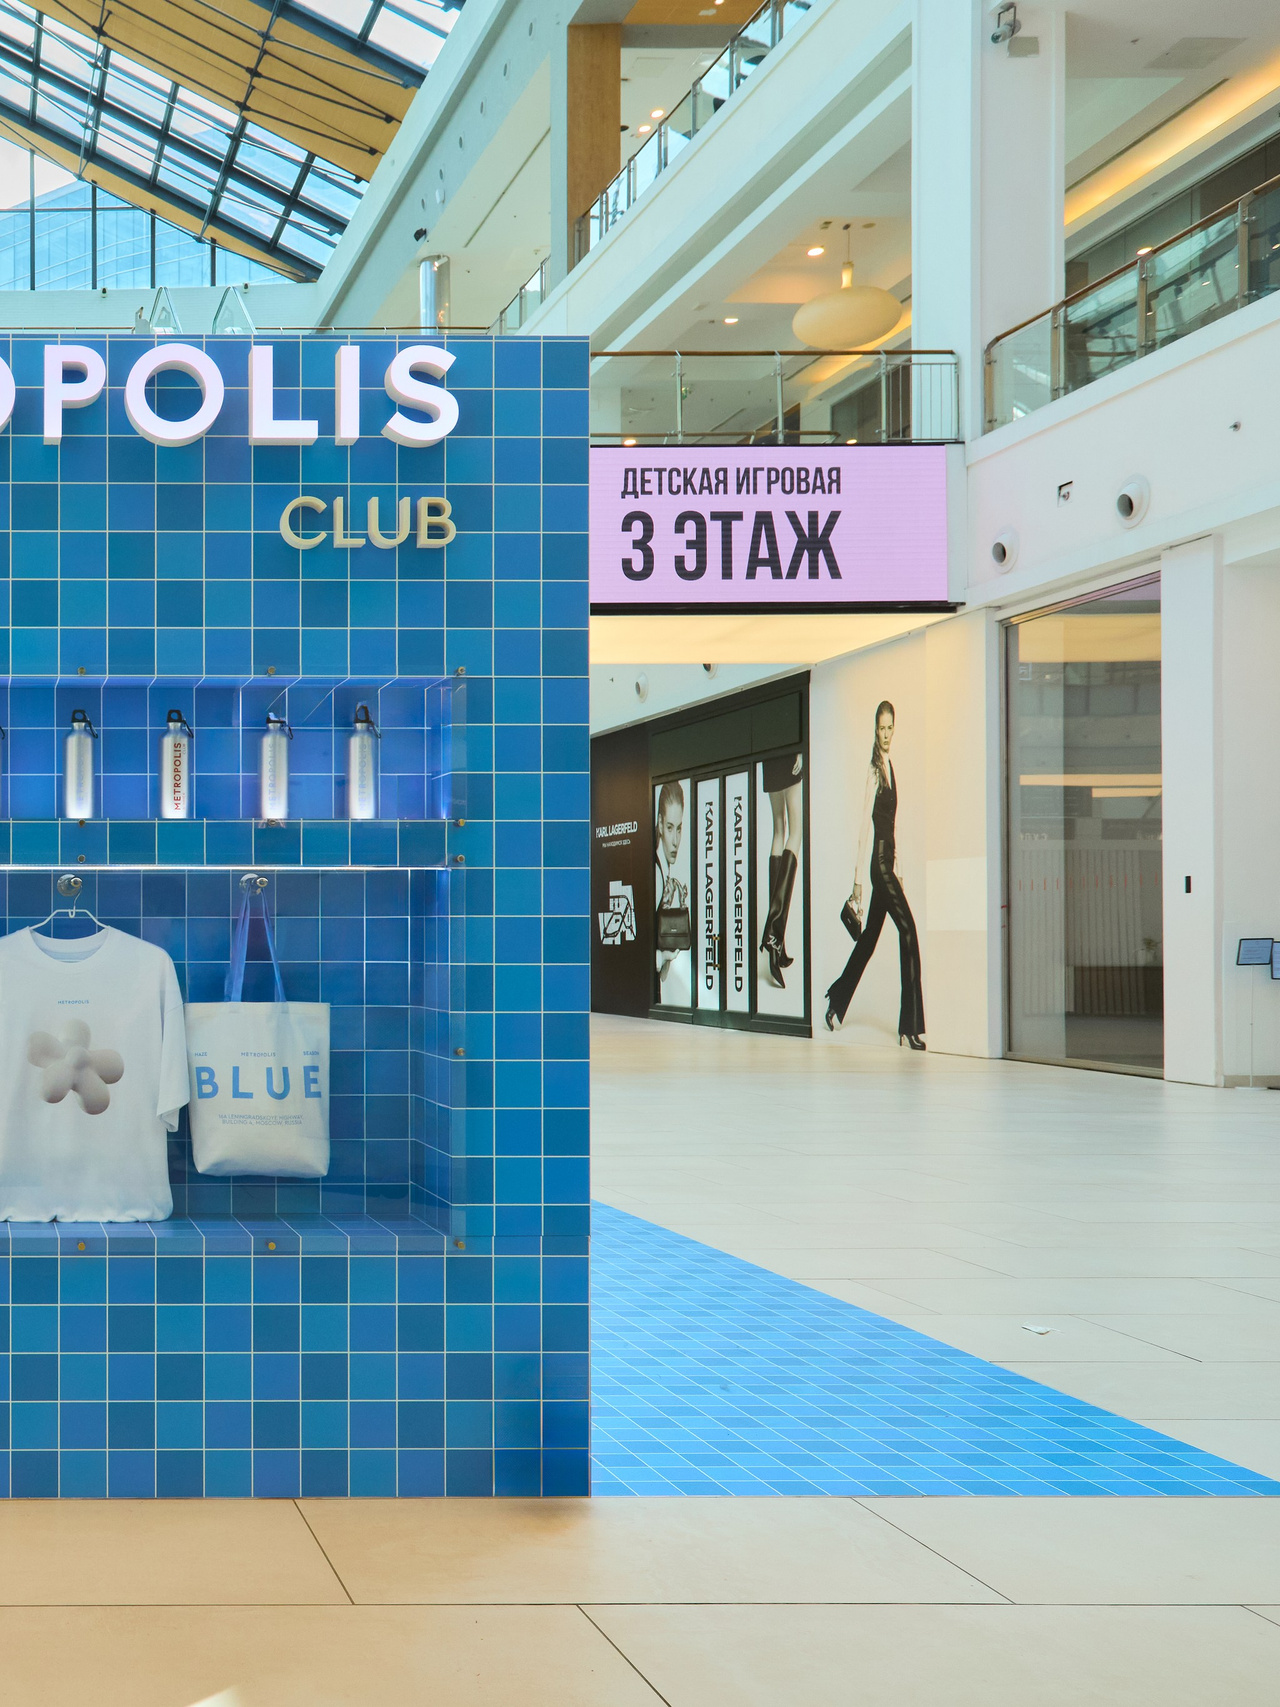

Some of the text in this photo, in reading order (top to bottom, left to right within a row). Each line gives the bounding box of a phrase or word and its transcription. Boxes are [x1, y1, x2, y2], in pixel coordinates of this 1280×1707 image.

[621, 467, 841, 499] ДЕТСКАЯ ИГРОВАЯ
[280, 495, 457, 549] CLUB
[621, 511, 842, 581] 3 ЭТАЖ
[173, 742, 182, 810] METROPOLIS
[596, 821, 638, 838] KARL LAGERFELD
[705, 801, 713, 991] KARL LAGERFELD
[734, 796, 742, 992] KARL LAGERFELD
[195, 1065, 322, 1100] BLUE
